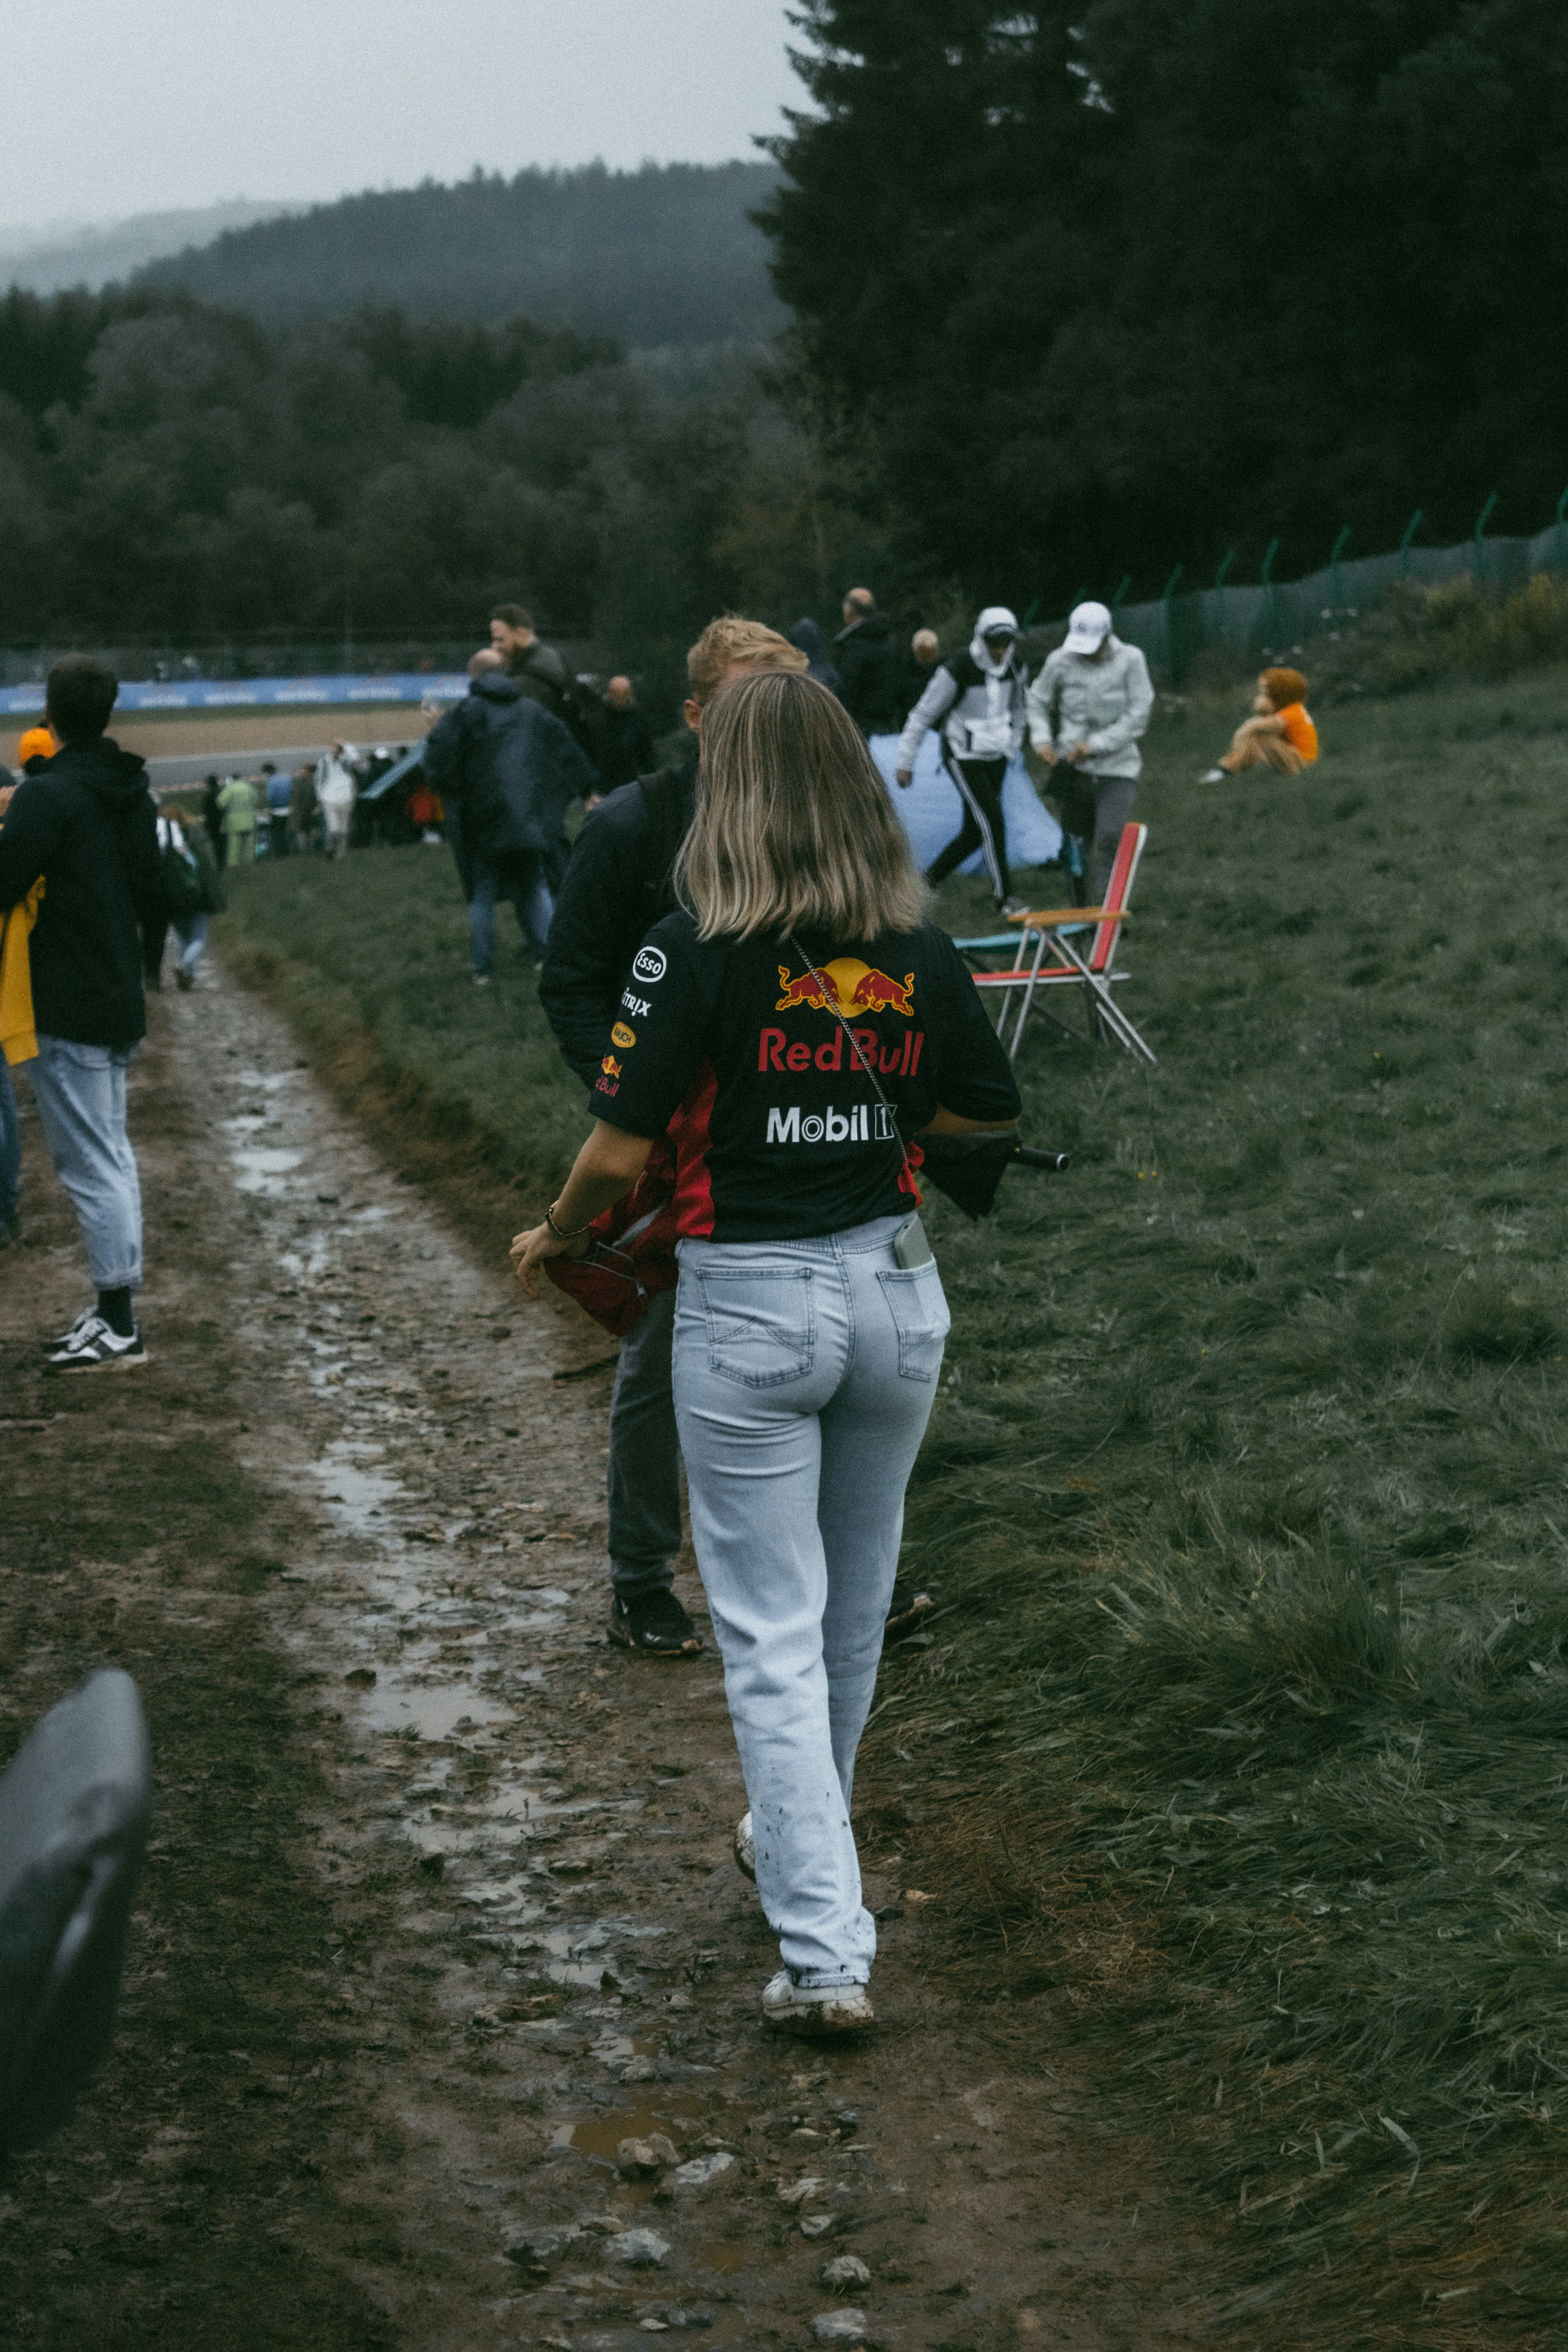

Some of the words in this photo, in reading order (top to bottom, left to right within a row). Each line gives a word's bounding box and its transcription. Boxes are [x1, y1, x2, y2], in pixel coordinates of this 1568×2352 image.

[758, 1025, 843, 1071] Red
[849, 1028, 925, 1076] Bull
[766, 1104, 869, 1143] Mobil
